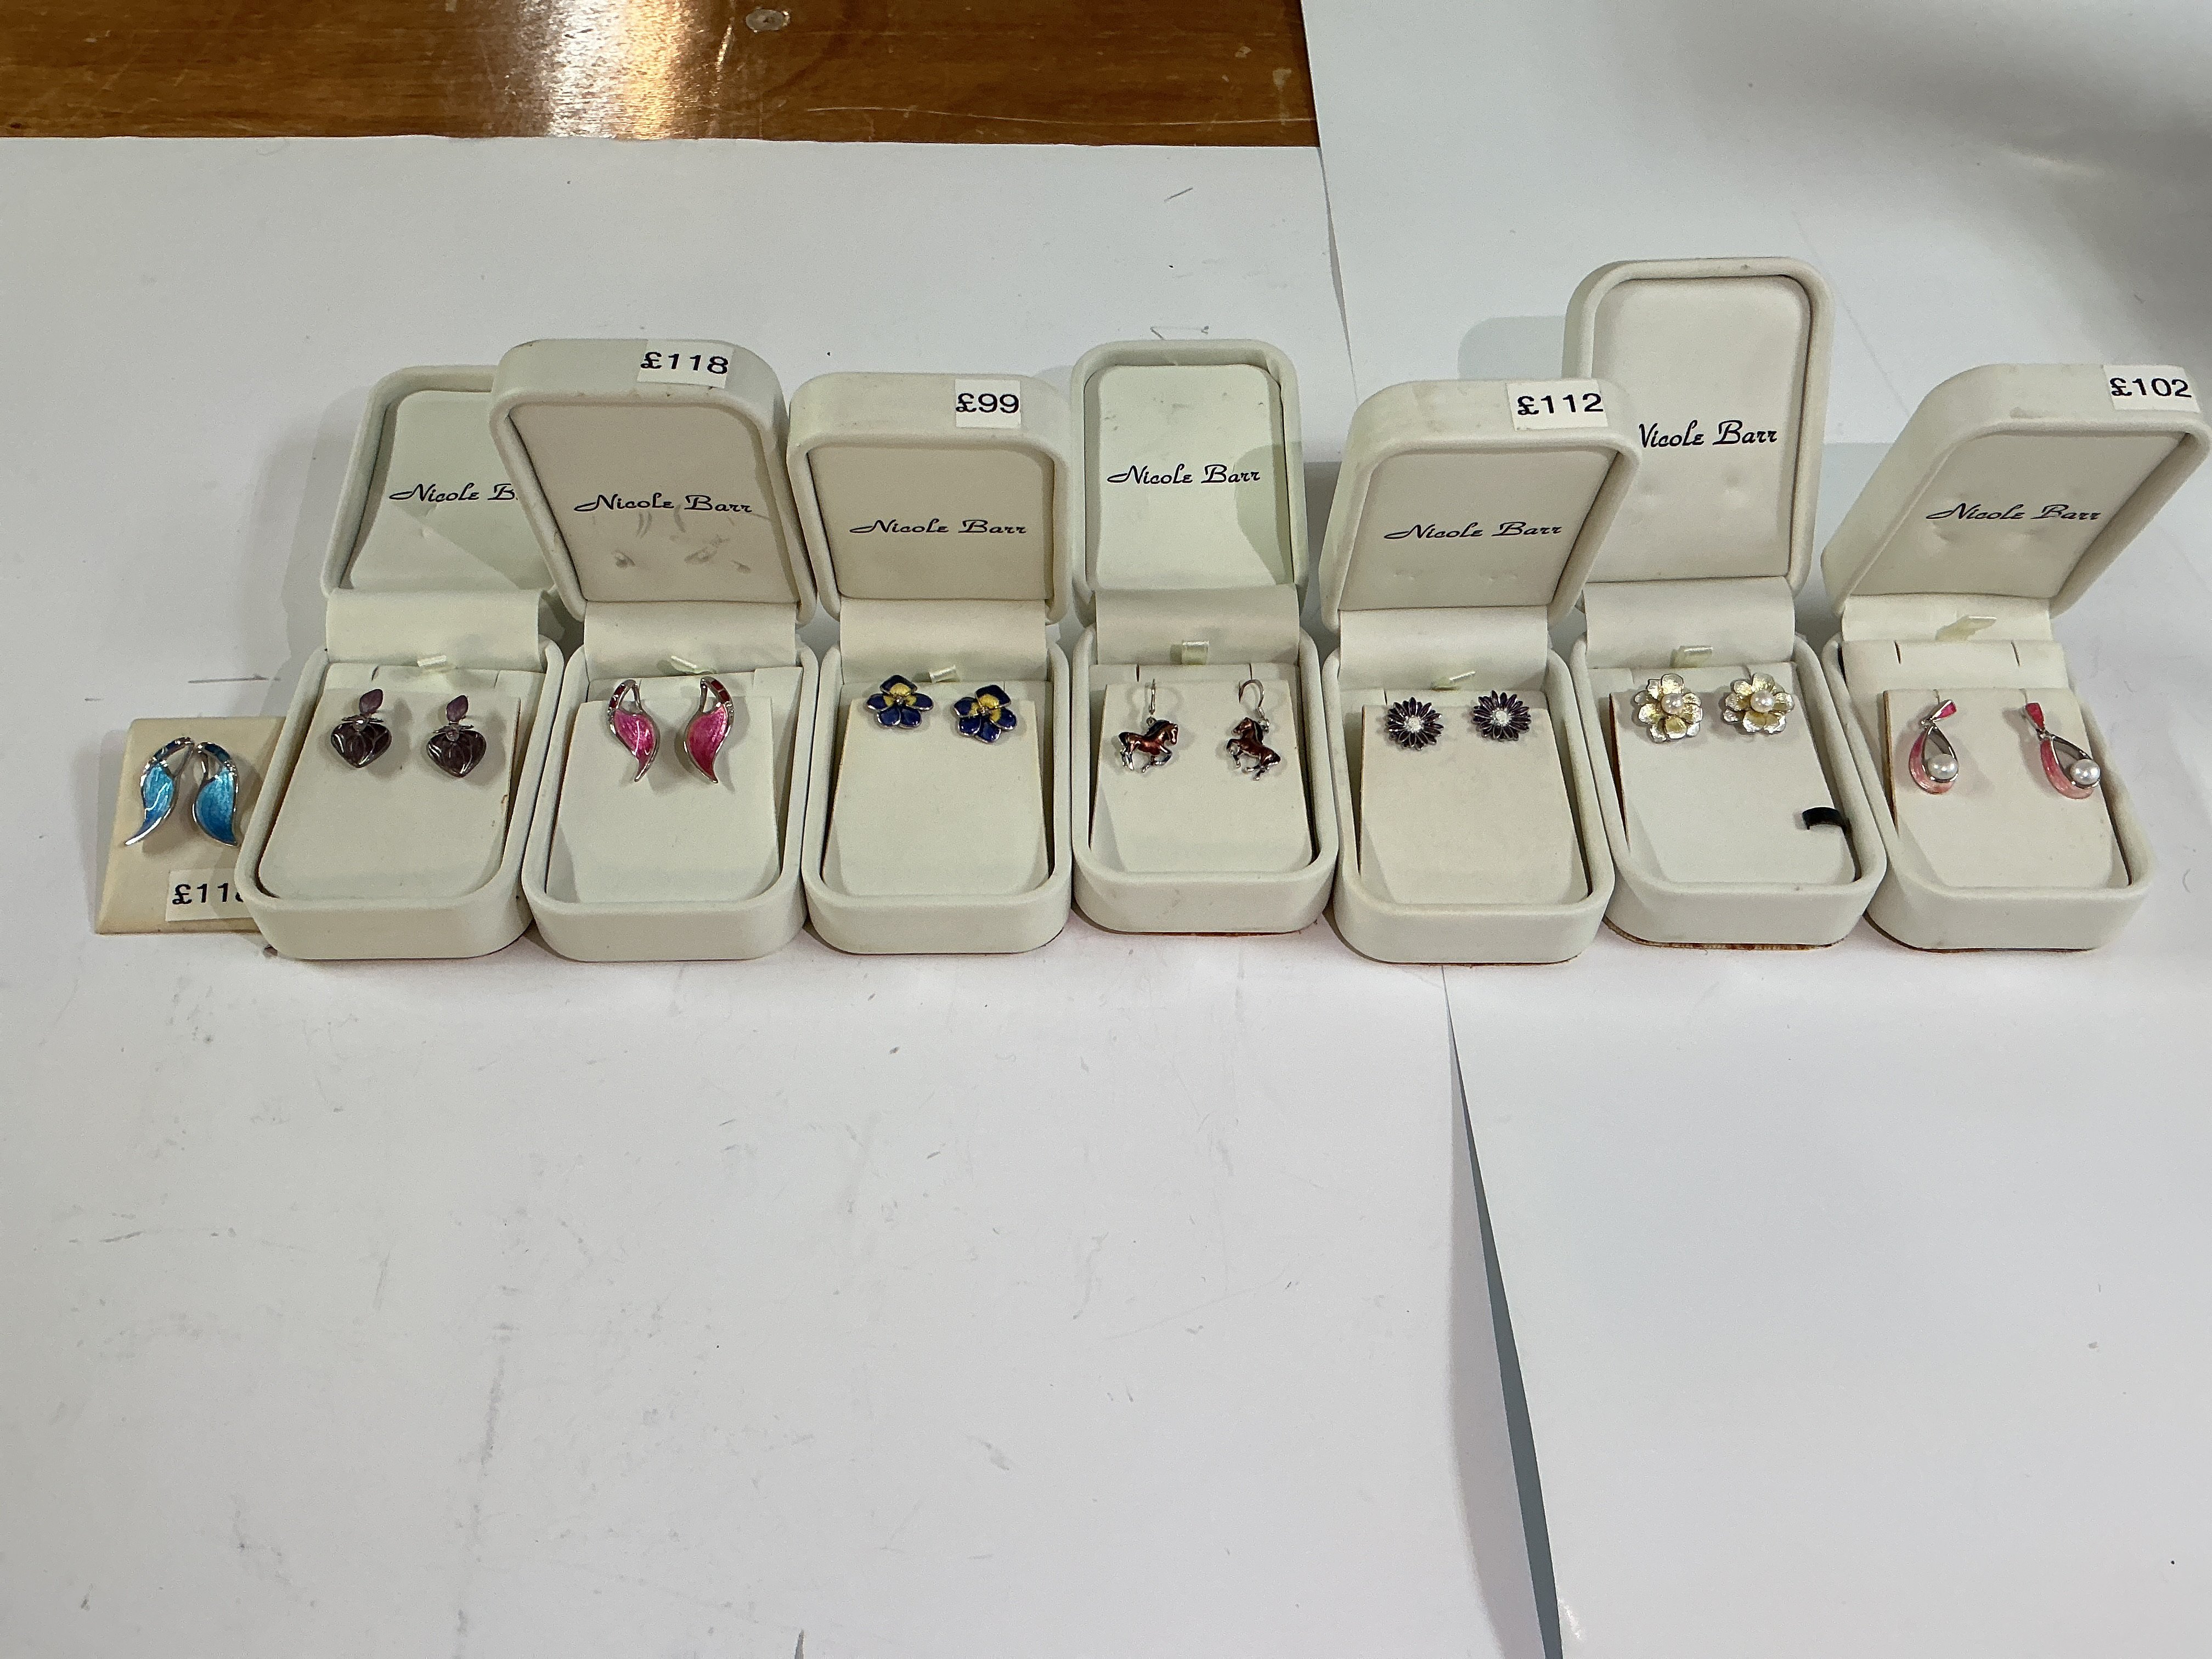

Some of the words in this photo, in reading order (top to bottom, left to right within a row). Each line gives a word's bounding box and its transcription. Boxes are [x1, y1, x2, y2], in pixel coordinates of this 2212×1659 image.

[640, 351, 729, 375] £118
[2109, 377, 2193, 399] £102
[955, 392, 1019, 414] £99
[1517, 393, 1604, 415] £112
[1712, 420, 1778, 446] Barr
[1107, 463, 1193, 485] Nicole
[1200, 463, 1261, 484] Barr
[389, 482, 480, 503] Nicole
[573, 492, 674, 513] Nicole
[684, 494, 753, 513] Barr
[1925, 503, 2024, 520] Nicole
[2030, 504, 2102, 521] Barr
[849, 518, 949, 534] Nicole
[958, 519, 1027, 534] Barr
[1384, 522, 1483, 539] Nicole
[1491, 521, 1562, 537] Barr
[172, 882, 244, 905] £11
